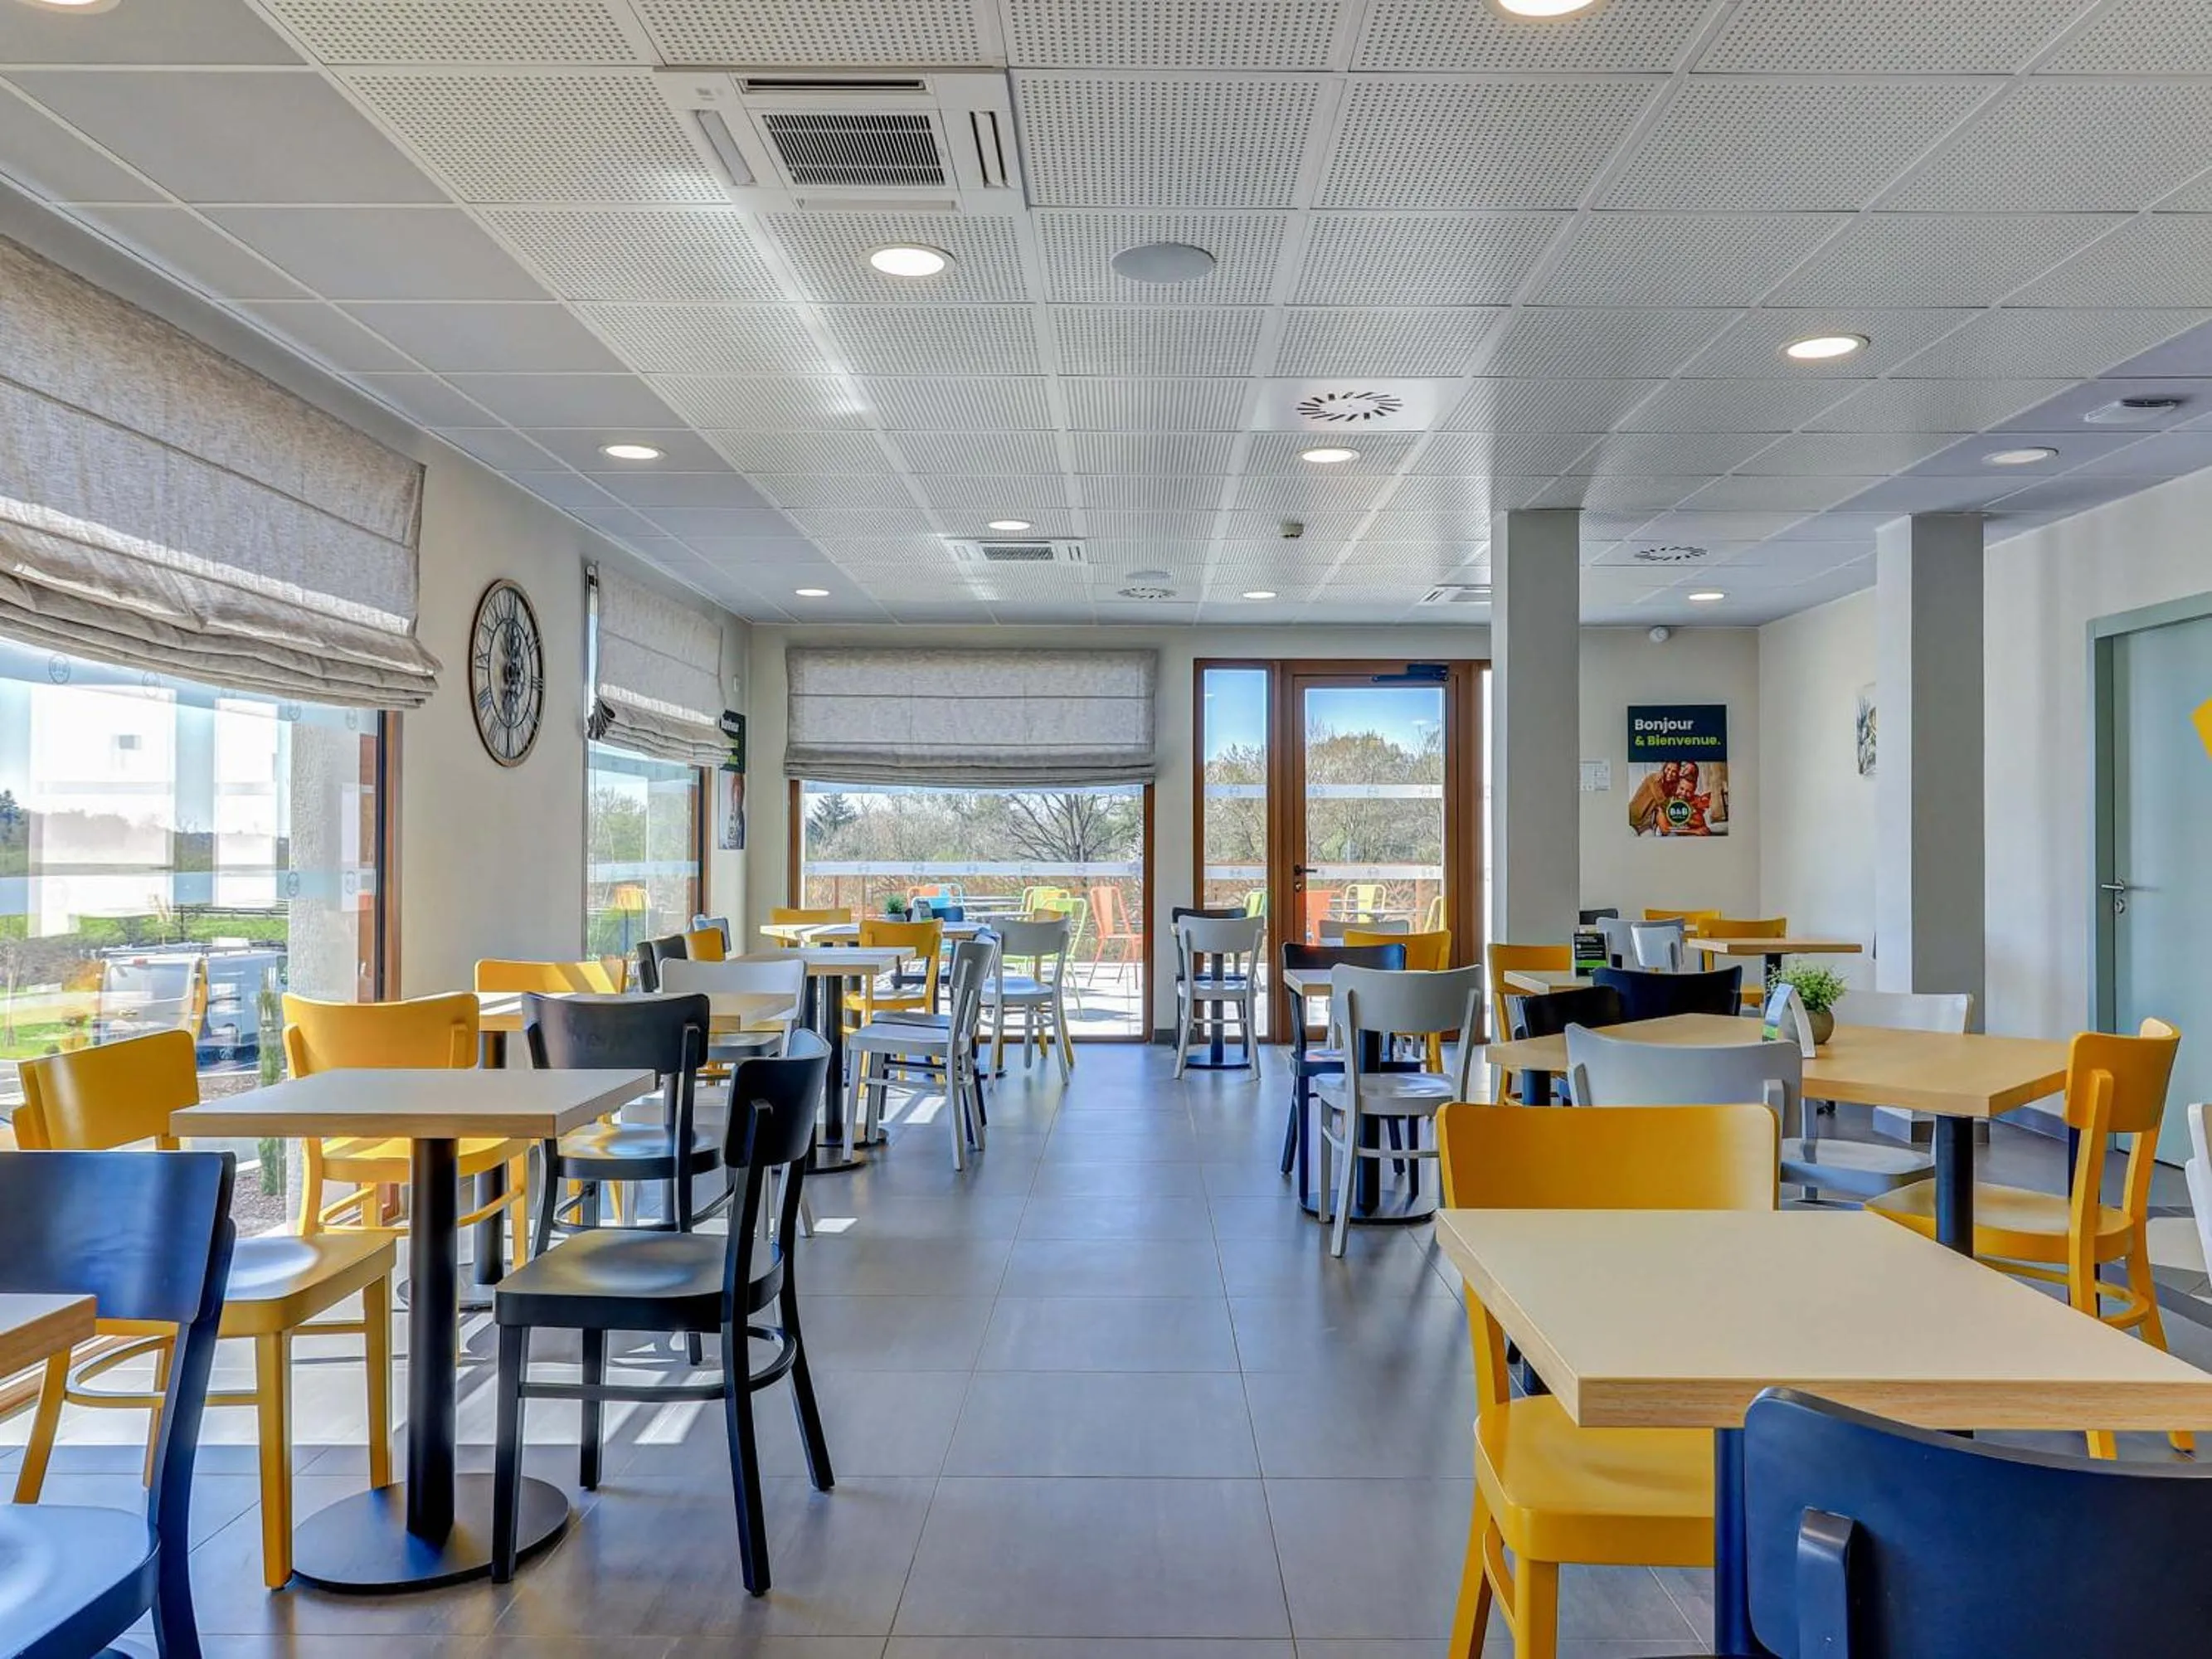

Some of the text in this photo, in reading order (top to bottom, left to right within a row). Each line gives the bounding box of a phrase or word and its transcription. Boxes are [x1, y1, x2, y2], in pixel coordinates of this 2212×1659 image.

[1634, 718, 1694, 733] Bonjour
[1635, 735, 1721, 746] & Bienvenue.
